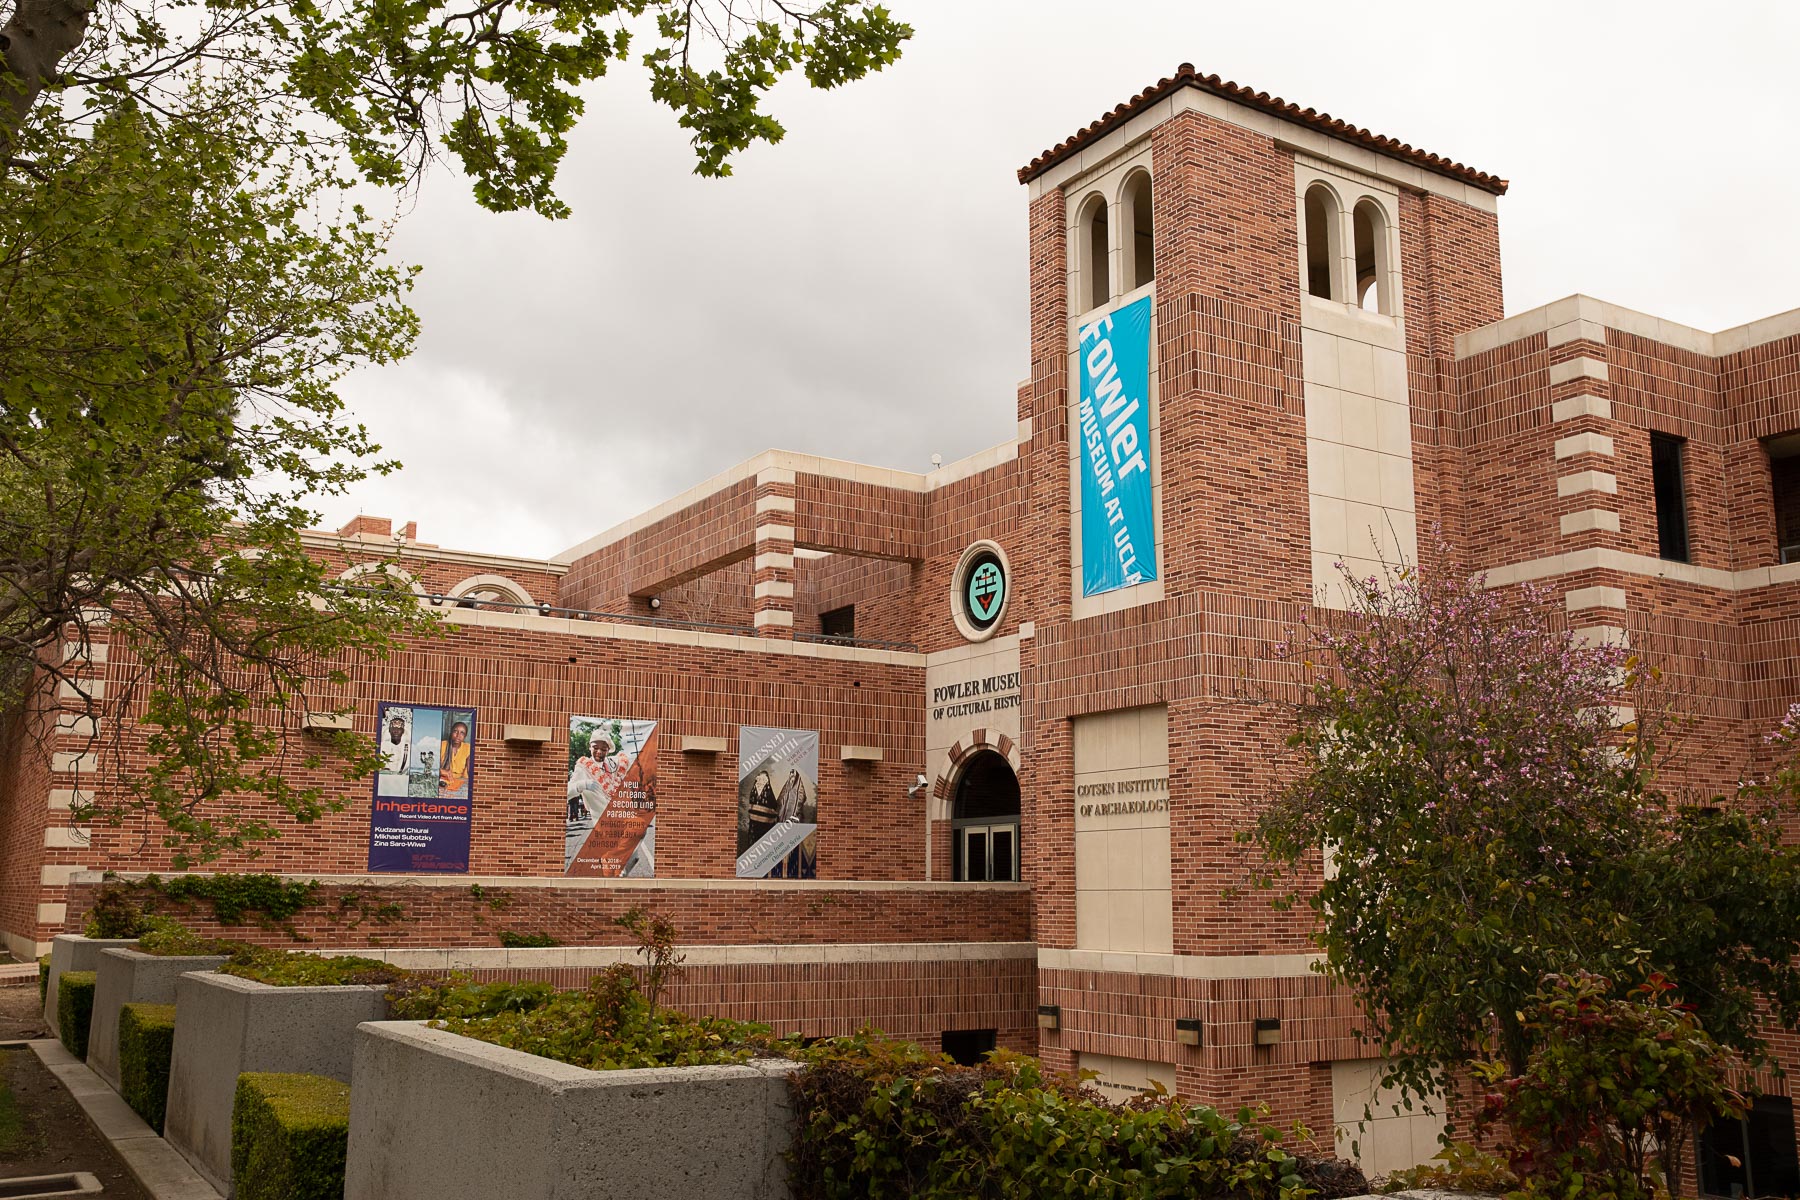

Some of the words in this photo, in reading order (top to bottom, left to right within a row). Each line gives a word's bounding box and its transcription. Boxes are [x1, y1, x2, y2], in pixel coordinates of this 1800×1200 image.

[1079, 396, 1115, 497] MUSEUM
[1104, 496, 1124, 527] AT
[1114, 525, 1143, 589] UCLA
[933, 680, 980, 703] FOWLER
[933, 708, 944, 720] OF
[947, 700, 991, 718] CULTURAL
[994, 694, 1020, 710] HISTO
[742, 732, 785, 772] DRESSED
[771, 737, 799, 763] WITH
[1077, 782, 1115, 797] COTSEN
[376, 800, 468, 814] Inheritance
[1080, 804, 1093, 817] OF
[1094, 798, 1170, 817] ARCHAEOLOGY
[401, 834, 433, 842] Subotzky
[739, 815, 800, 870] DISTINCTION
